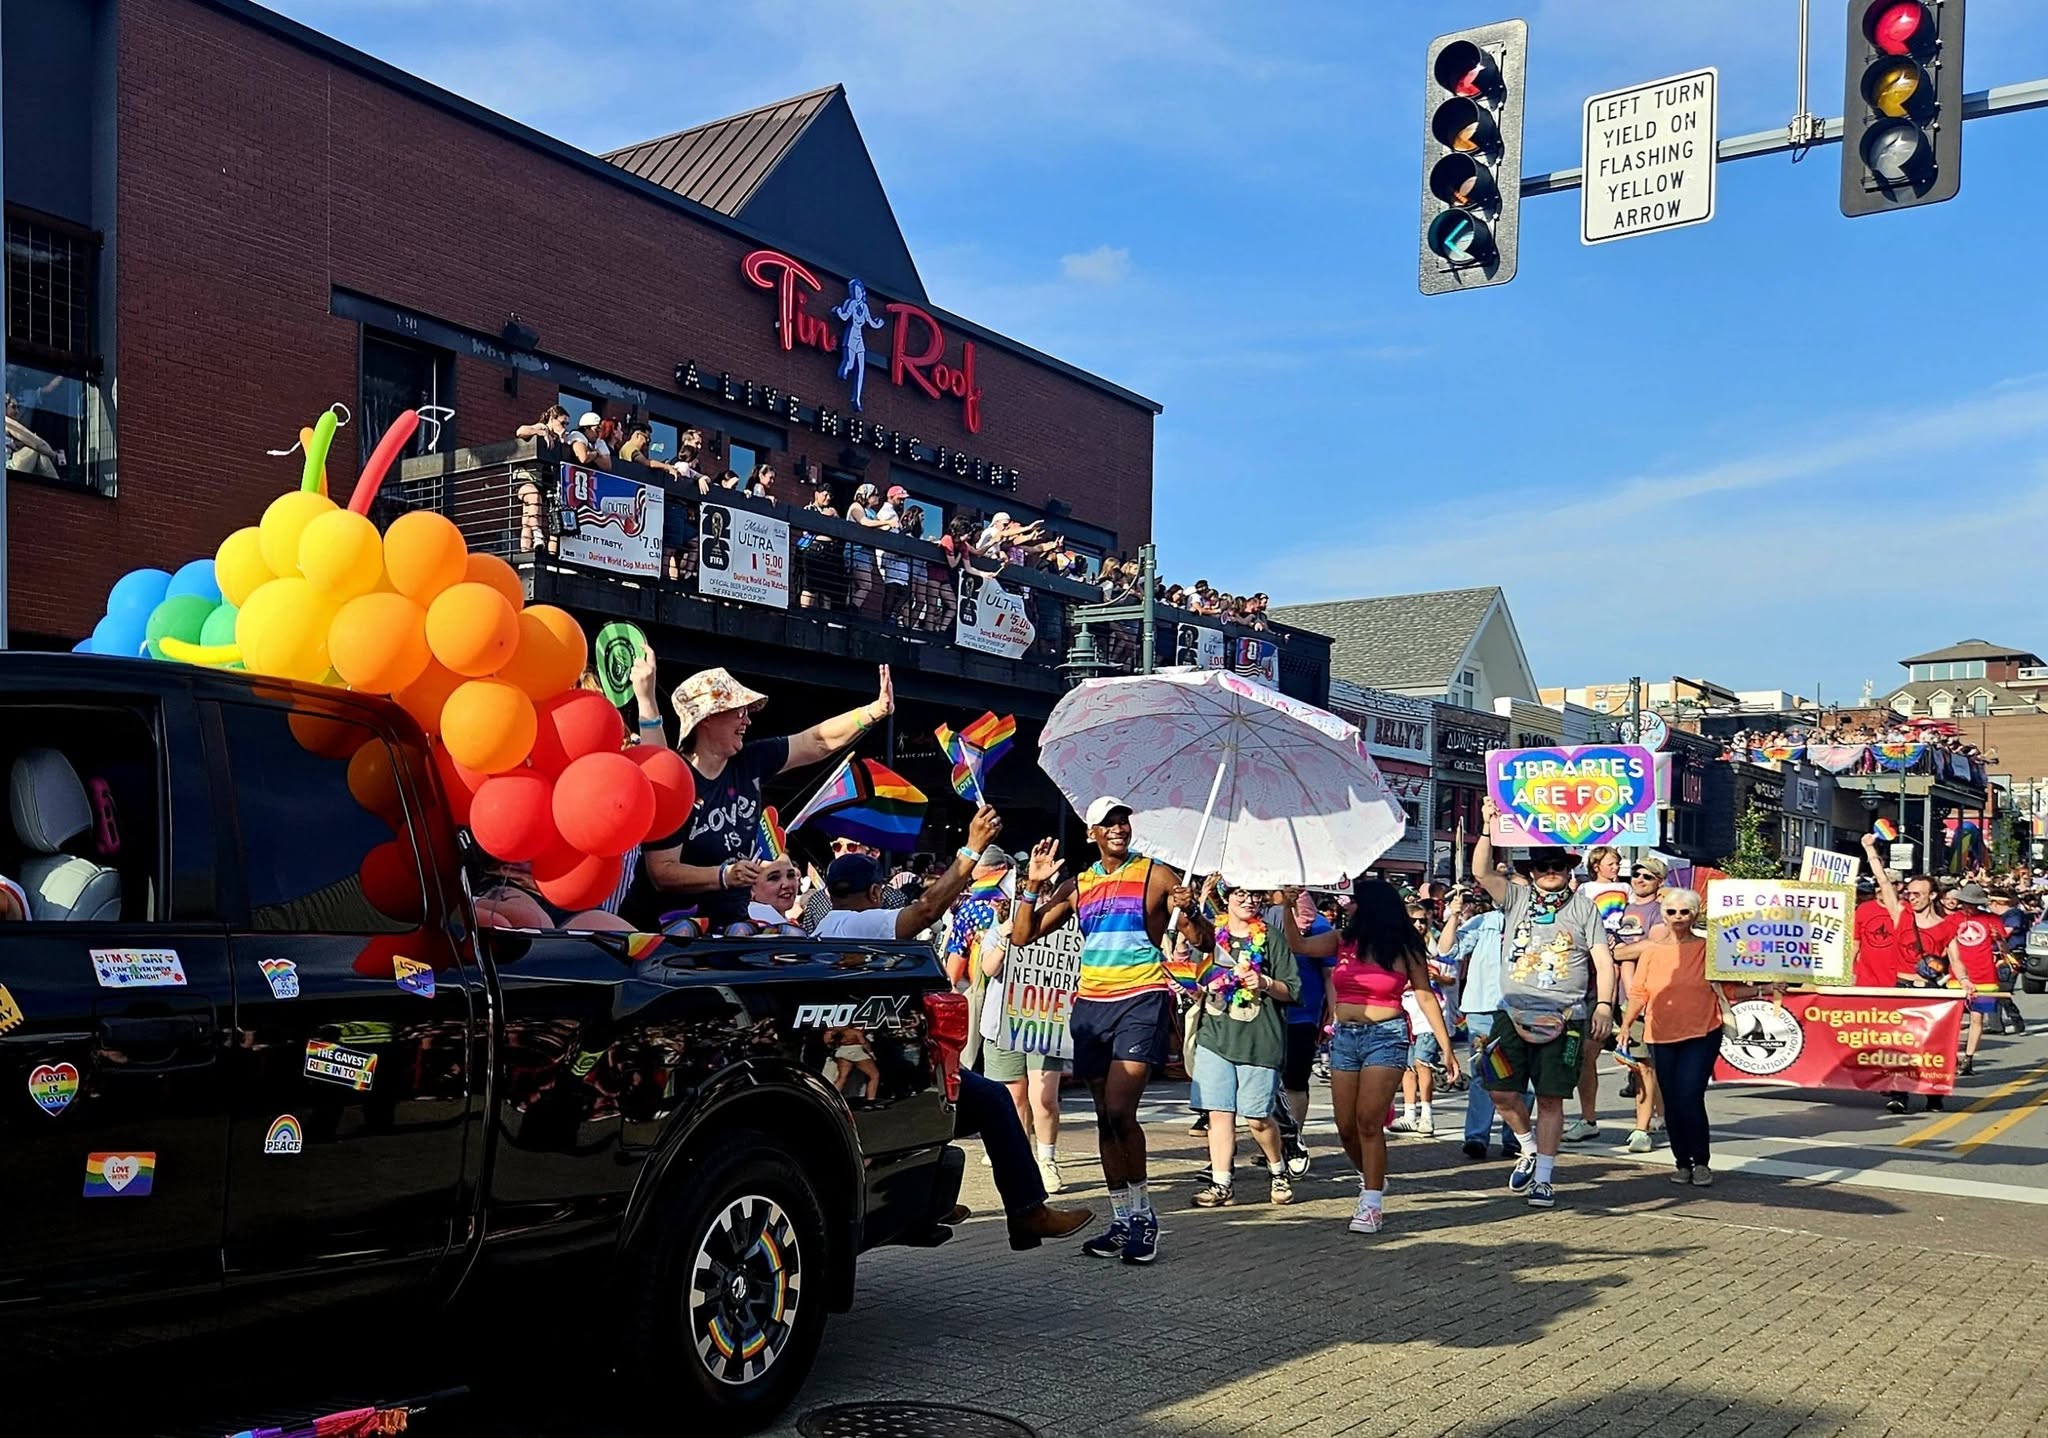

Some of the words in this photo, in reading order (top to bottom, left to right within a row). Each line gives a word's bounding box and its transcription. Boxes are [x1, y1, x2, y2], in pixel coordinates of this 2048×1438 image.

[1597, 97, 1640, 122] LEFT
[1655, 81, 1704, 108] TURN
[1604, 121, 1656, 148] YIELD
[1671, 111, 1696, 133] ON
[1600, 141, 1693, 177] FLASHING
[1608, 170, 1684, 202] YELLOW
[1614, 199, 1681, 229] ARROW
[741, 250, 836, 351] Tin
[886, 303, 982, 433] Roof
[685, 360, 700, 389] A
[722, 372, 800, 423] LIVE
[819, 406, 921, 461] MUSIC
[938, 446, 1020, 492] JOINT
[738, 531, 775, 552] ULTRA
[589, 552, 607, 564] During
[607, 555, 622, 564] World
[623, 559, 634, 569] Cup
[709, 556, 724, 566] FIFA
[762, 553, 783, 569] $5.00
[1375, 718, 1424, 750] BELLY'S
[1498, 758, 1645, 780] LIBRARIES
[1512, 786, 1567, 806] ARE
[1577, 785, 1634, 806] FOR
[1500, 812, 1648, 833] EVERYONE
[1812, 851, 1851, 874] UNION
[1722, 895, 1745, 907] BE
[1755, 894, 1839, 910] CAREFUL
[1760, 908, 1795, 921] YOU
[1800, 910, 1843, 933] HATE
[1723, 927, 1741, 943] IT
[1747, 924, 1804, 937] COULD
[1811, 927, 1835, 944] BE
[1736, 940, 1820, 955] SOMEONE
[104, 953, 123, 964] I'M
[141, 953, 163, 964] GAY
[1731, 954, 1766, 967] YOU
[1781, 955, 1824, 969] LOVE
[1013, 967, 1081, 991] NETWORK
[0, 1007, 13, 1023] AY
[1804, 1006, 1908, 1028] Organize,
[1009, 1017, 1064, 1056] YOU!
[1778, 1011, 1799, 1052] DUCATION
[1837, 1028, 1920, 1048] agitate,
[310, 1060, 330, 1073] RIDE
[332, 1064, 341, 1075] IN
[317, 1049, 333, 1060] THE
[335, 1052, 367, 1067] GAYEST
[1727, 1053, 1788, 1071] ASSOCIATION
[1857, 1050, 1945, 1068] educate
[41, 1073, 67, 1083] LOVE
[1920, 1071, 1952, 1081] Anthony
[49, 1085, 58, 1093] IS
[42, 1095, 68, 1104] LOVE
[266, 1142, 300, 1151] PEACE
[112, 1165, 130, 1173] LOVE
